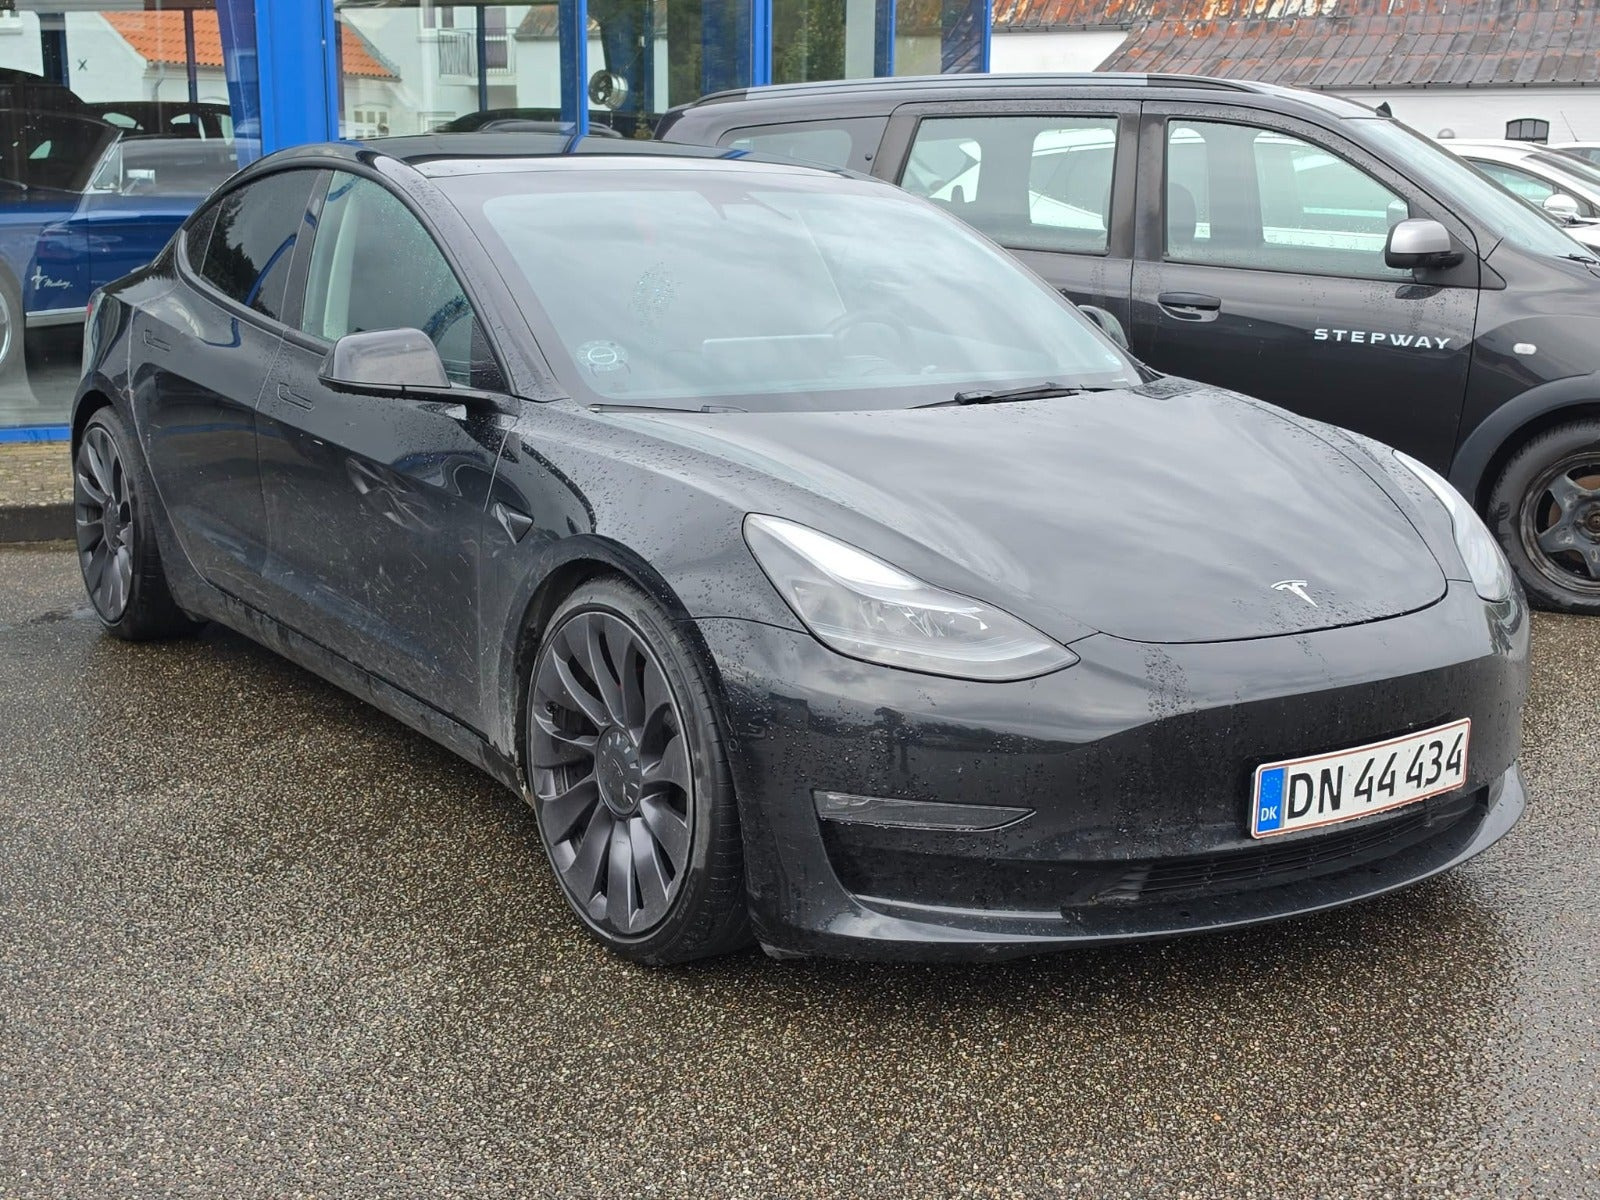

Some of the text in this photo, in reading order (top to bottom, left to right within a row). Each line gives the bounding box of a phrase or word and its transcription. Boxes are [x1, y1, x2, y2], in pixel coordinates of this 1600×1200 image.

[1313, 328, 1451, 350] STEPWAY
[1287, 732, 1464, 820] DN 44 434
[1260, 804, 1278, 822] DK
